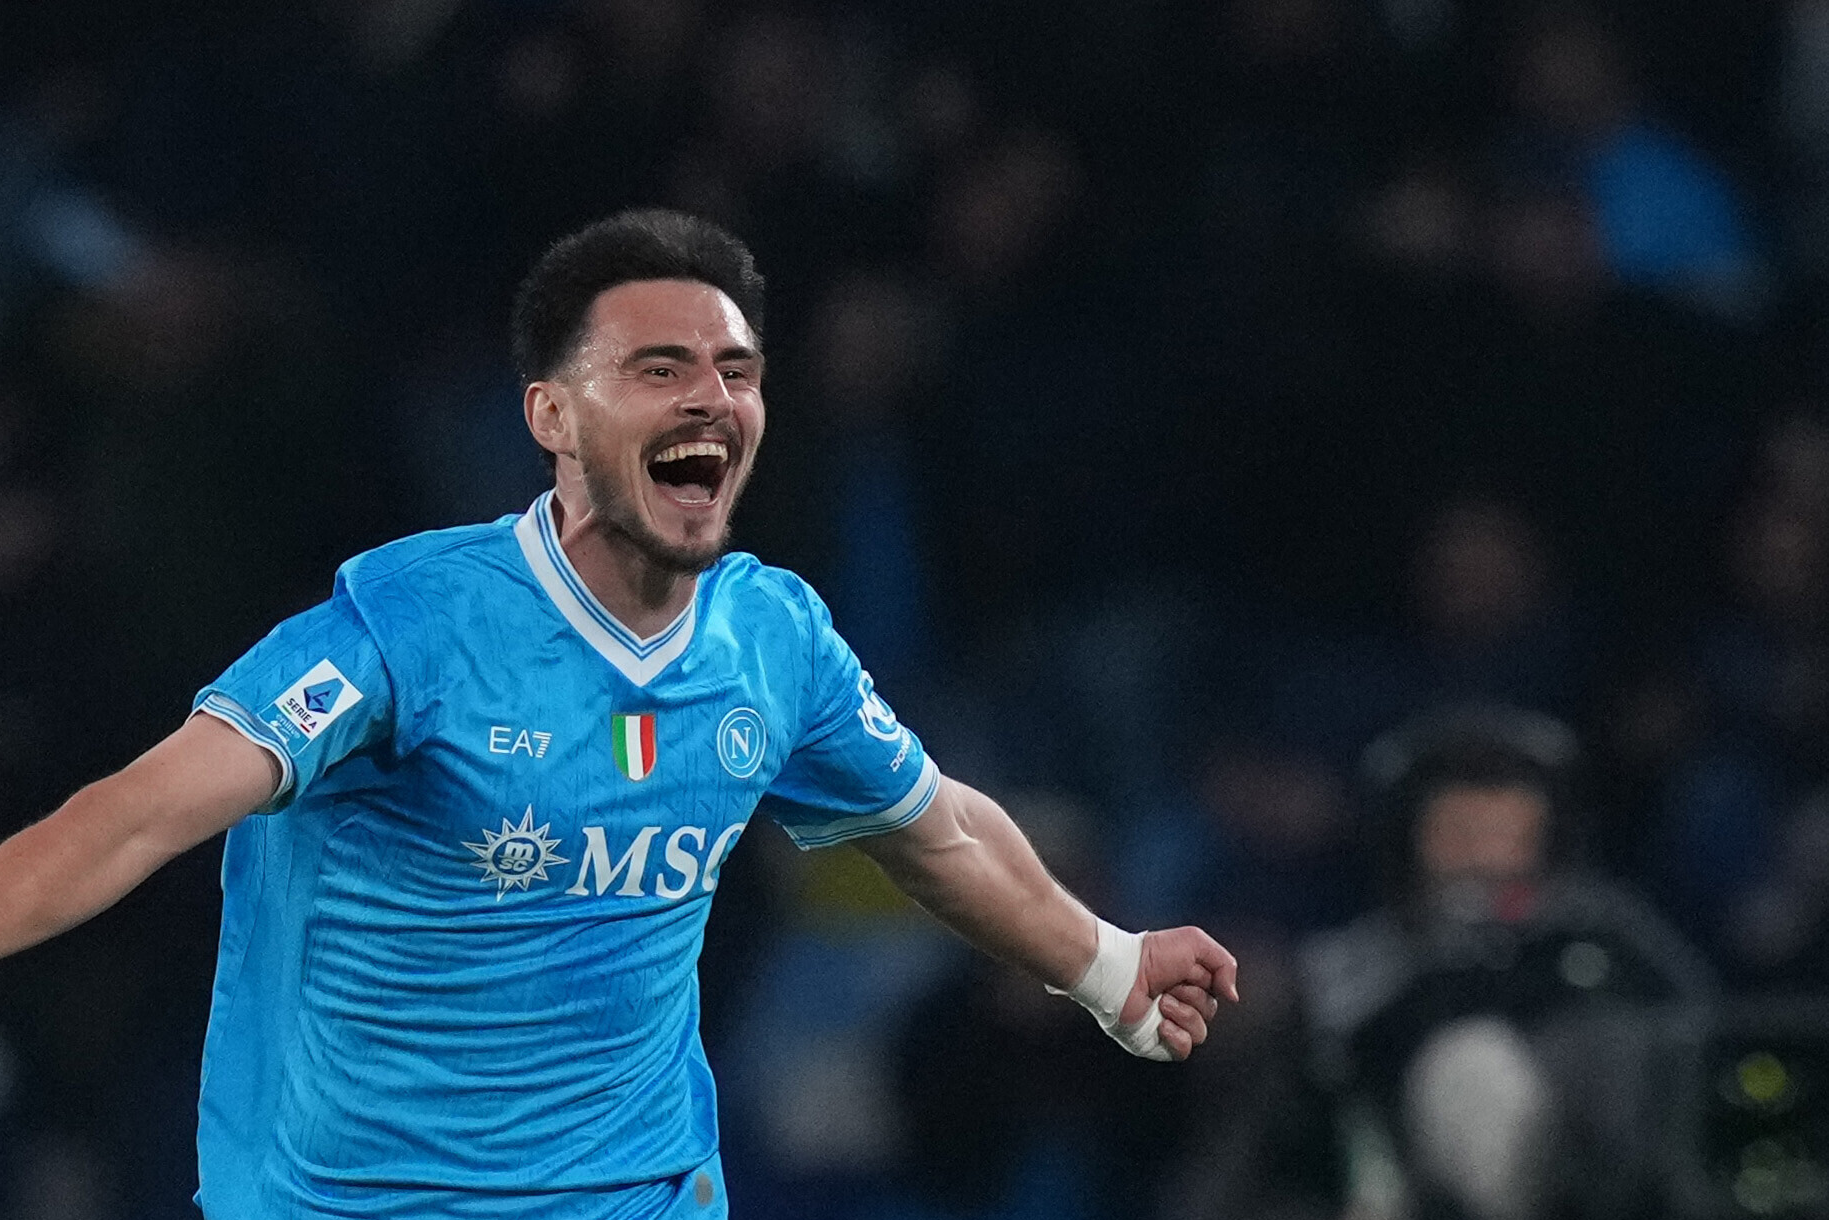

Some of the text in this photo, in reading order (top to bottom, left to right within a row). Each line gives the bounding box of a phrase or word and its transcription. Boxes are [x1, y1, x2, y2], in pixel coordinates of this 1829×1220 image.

[285, 697, 318, 730] SERIE A
[488, 725, 553, 759] EA7
[729, 726, 751, 759] N
[564, 822, 749, 900] MSC
